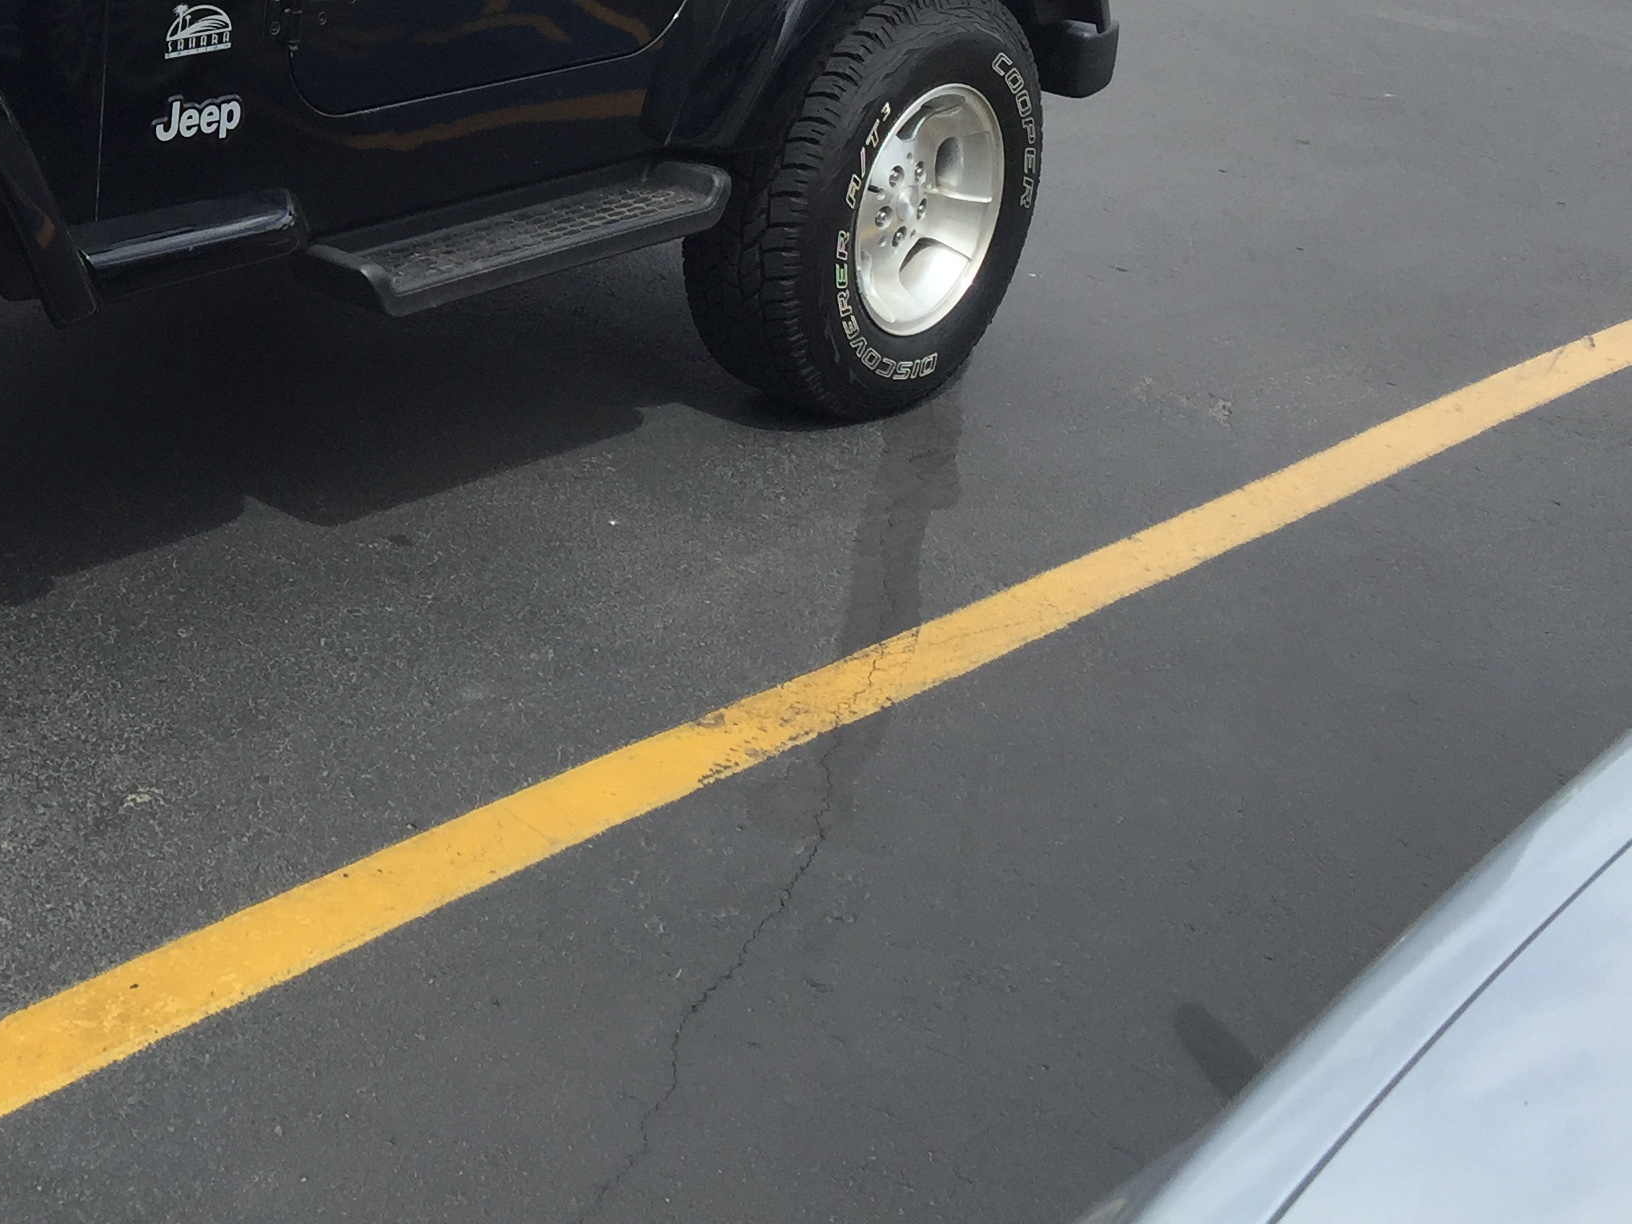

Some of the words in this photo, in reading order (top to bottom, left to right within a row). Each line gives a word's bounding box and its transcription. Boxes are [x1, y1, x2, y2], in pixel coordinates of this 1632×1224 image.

[168, 32, 230, 52] SAHARA
[155, 100, 242, 142] Jeep
[991, 52, 1038, 209] COOPER
[834, 230, 938, 380] DISCOVERER
